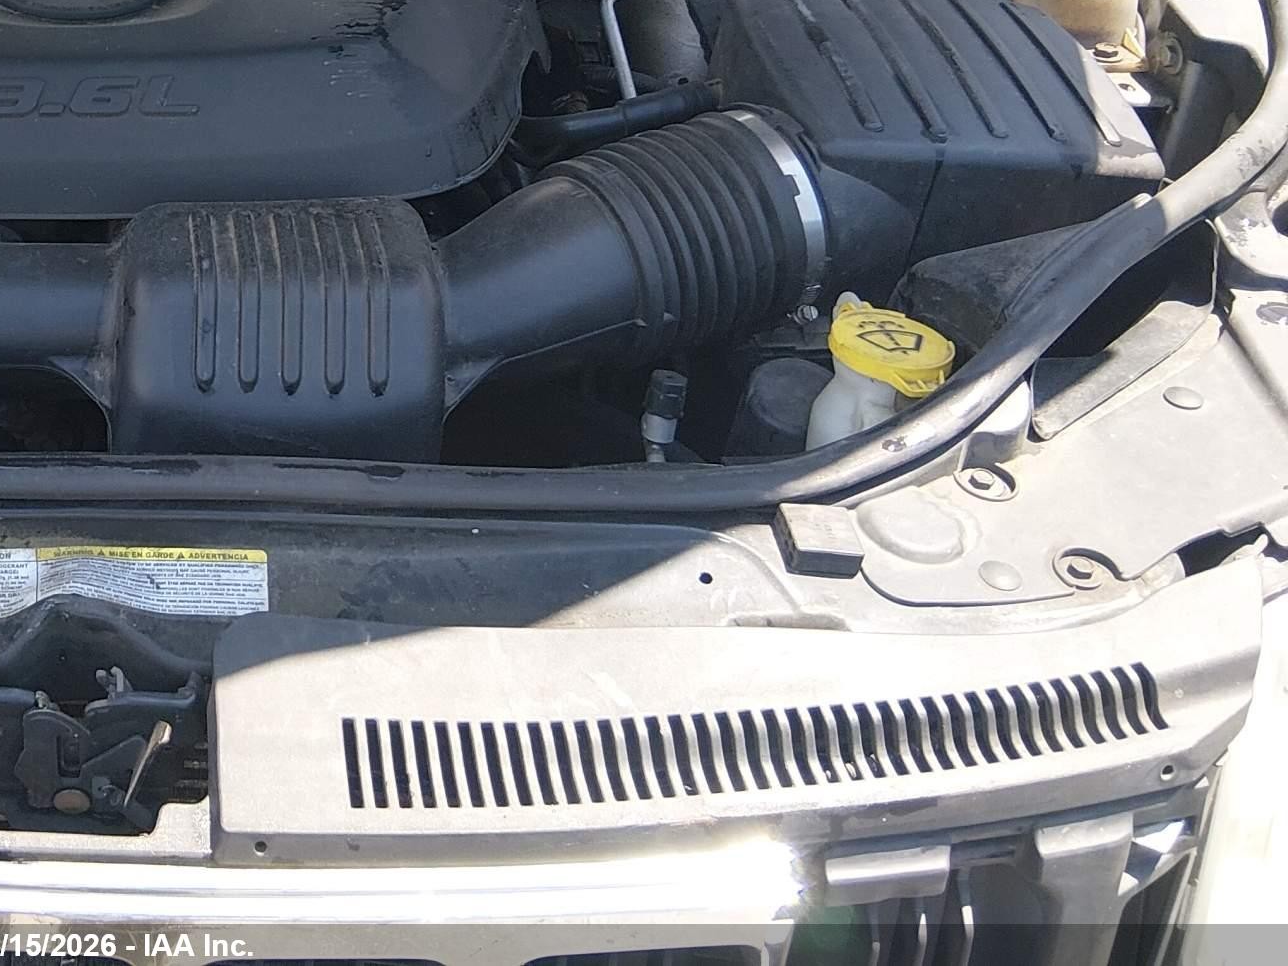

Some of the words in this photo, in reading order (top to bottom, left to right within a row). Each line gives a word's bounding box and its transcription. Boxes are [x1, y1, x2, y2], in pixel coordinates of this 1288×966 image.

[53, 549, 94, 557] WARNING
[109, 550, 130, 558] MISE
[145, 551, 175, 559] GARDE
[188, 552, 249, 560] ADVERTENCIA
